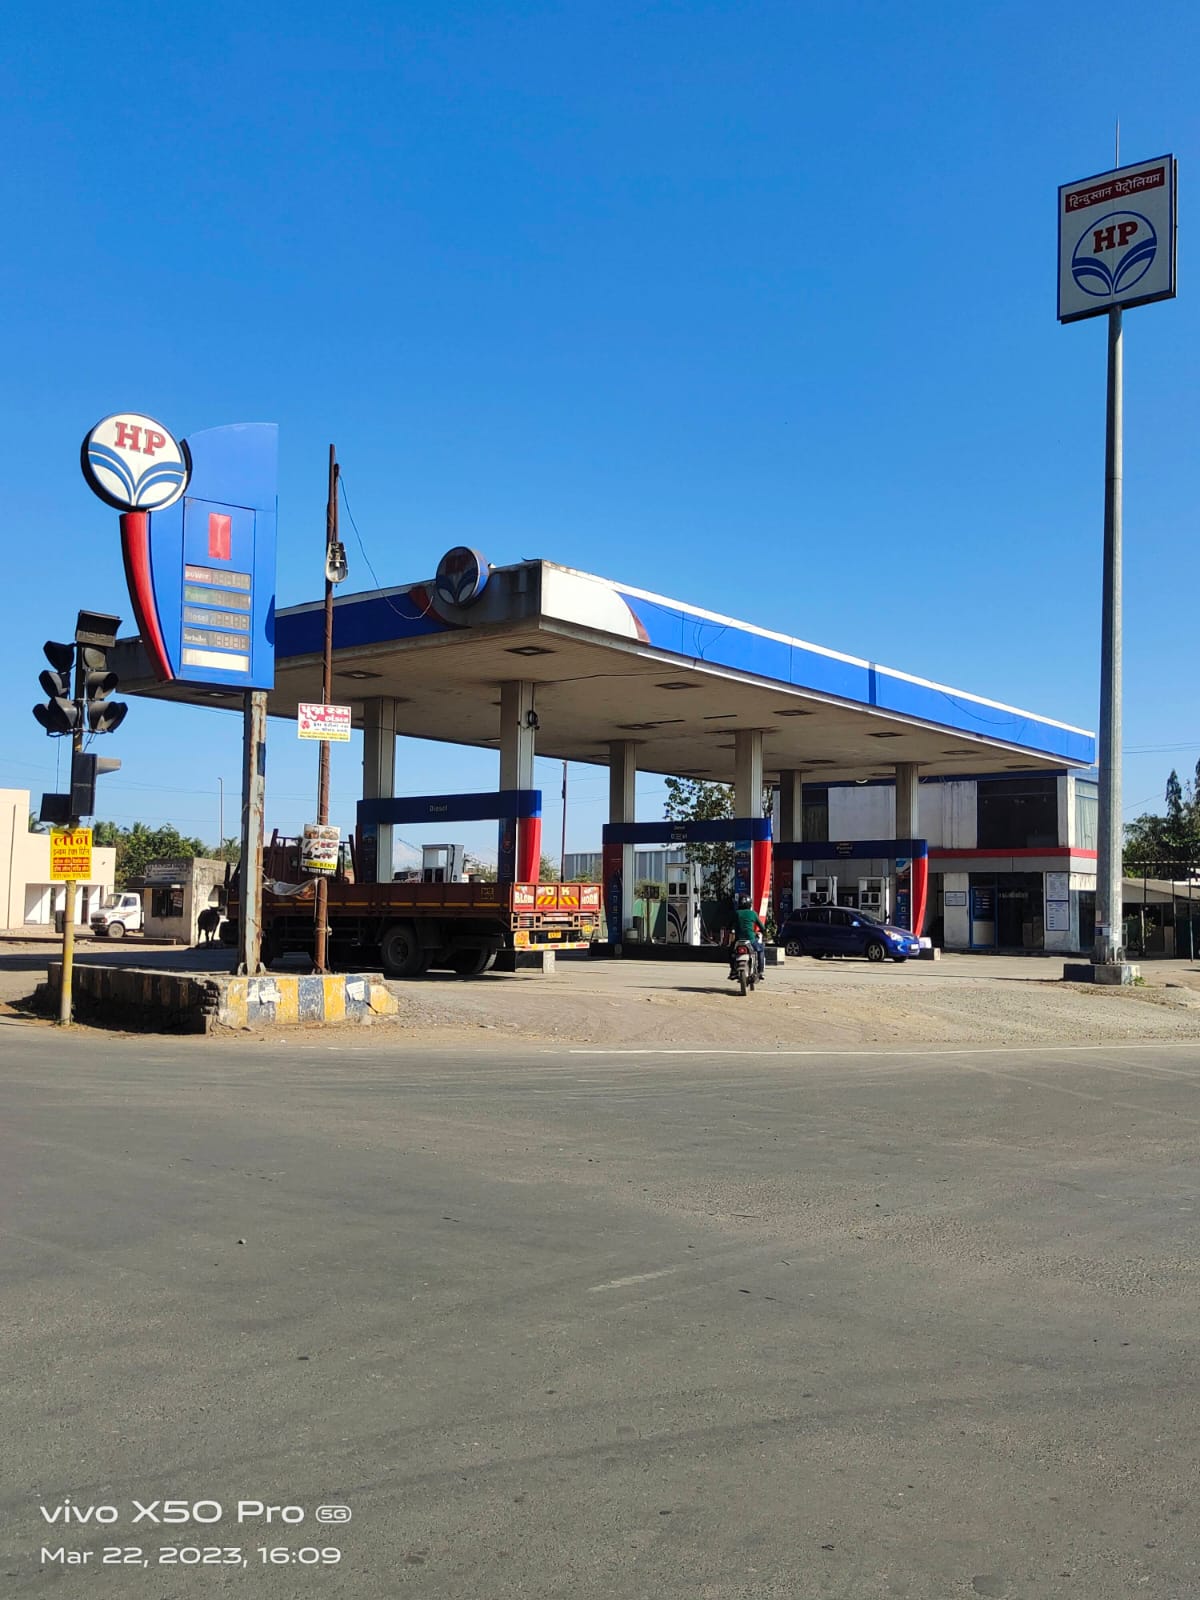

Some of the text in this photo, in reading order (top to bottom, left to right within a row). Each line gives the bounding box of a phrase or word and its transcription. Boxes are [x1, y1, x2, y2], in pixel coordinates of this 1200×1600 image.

[1069, 172, 1161, 208] हिन्दुस्तान पेट्रोलियम
[1093, 221, 1138, 254] HP
[114, 421, 166, 457] HP
